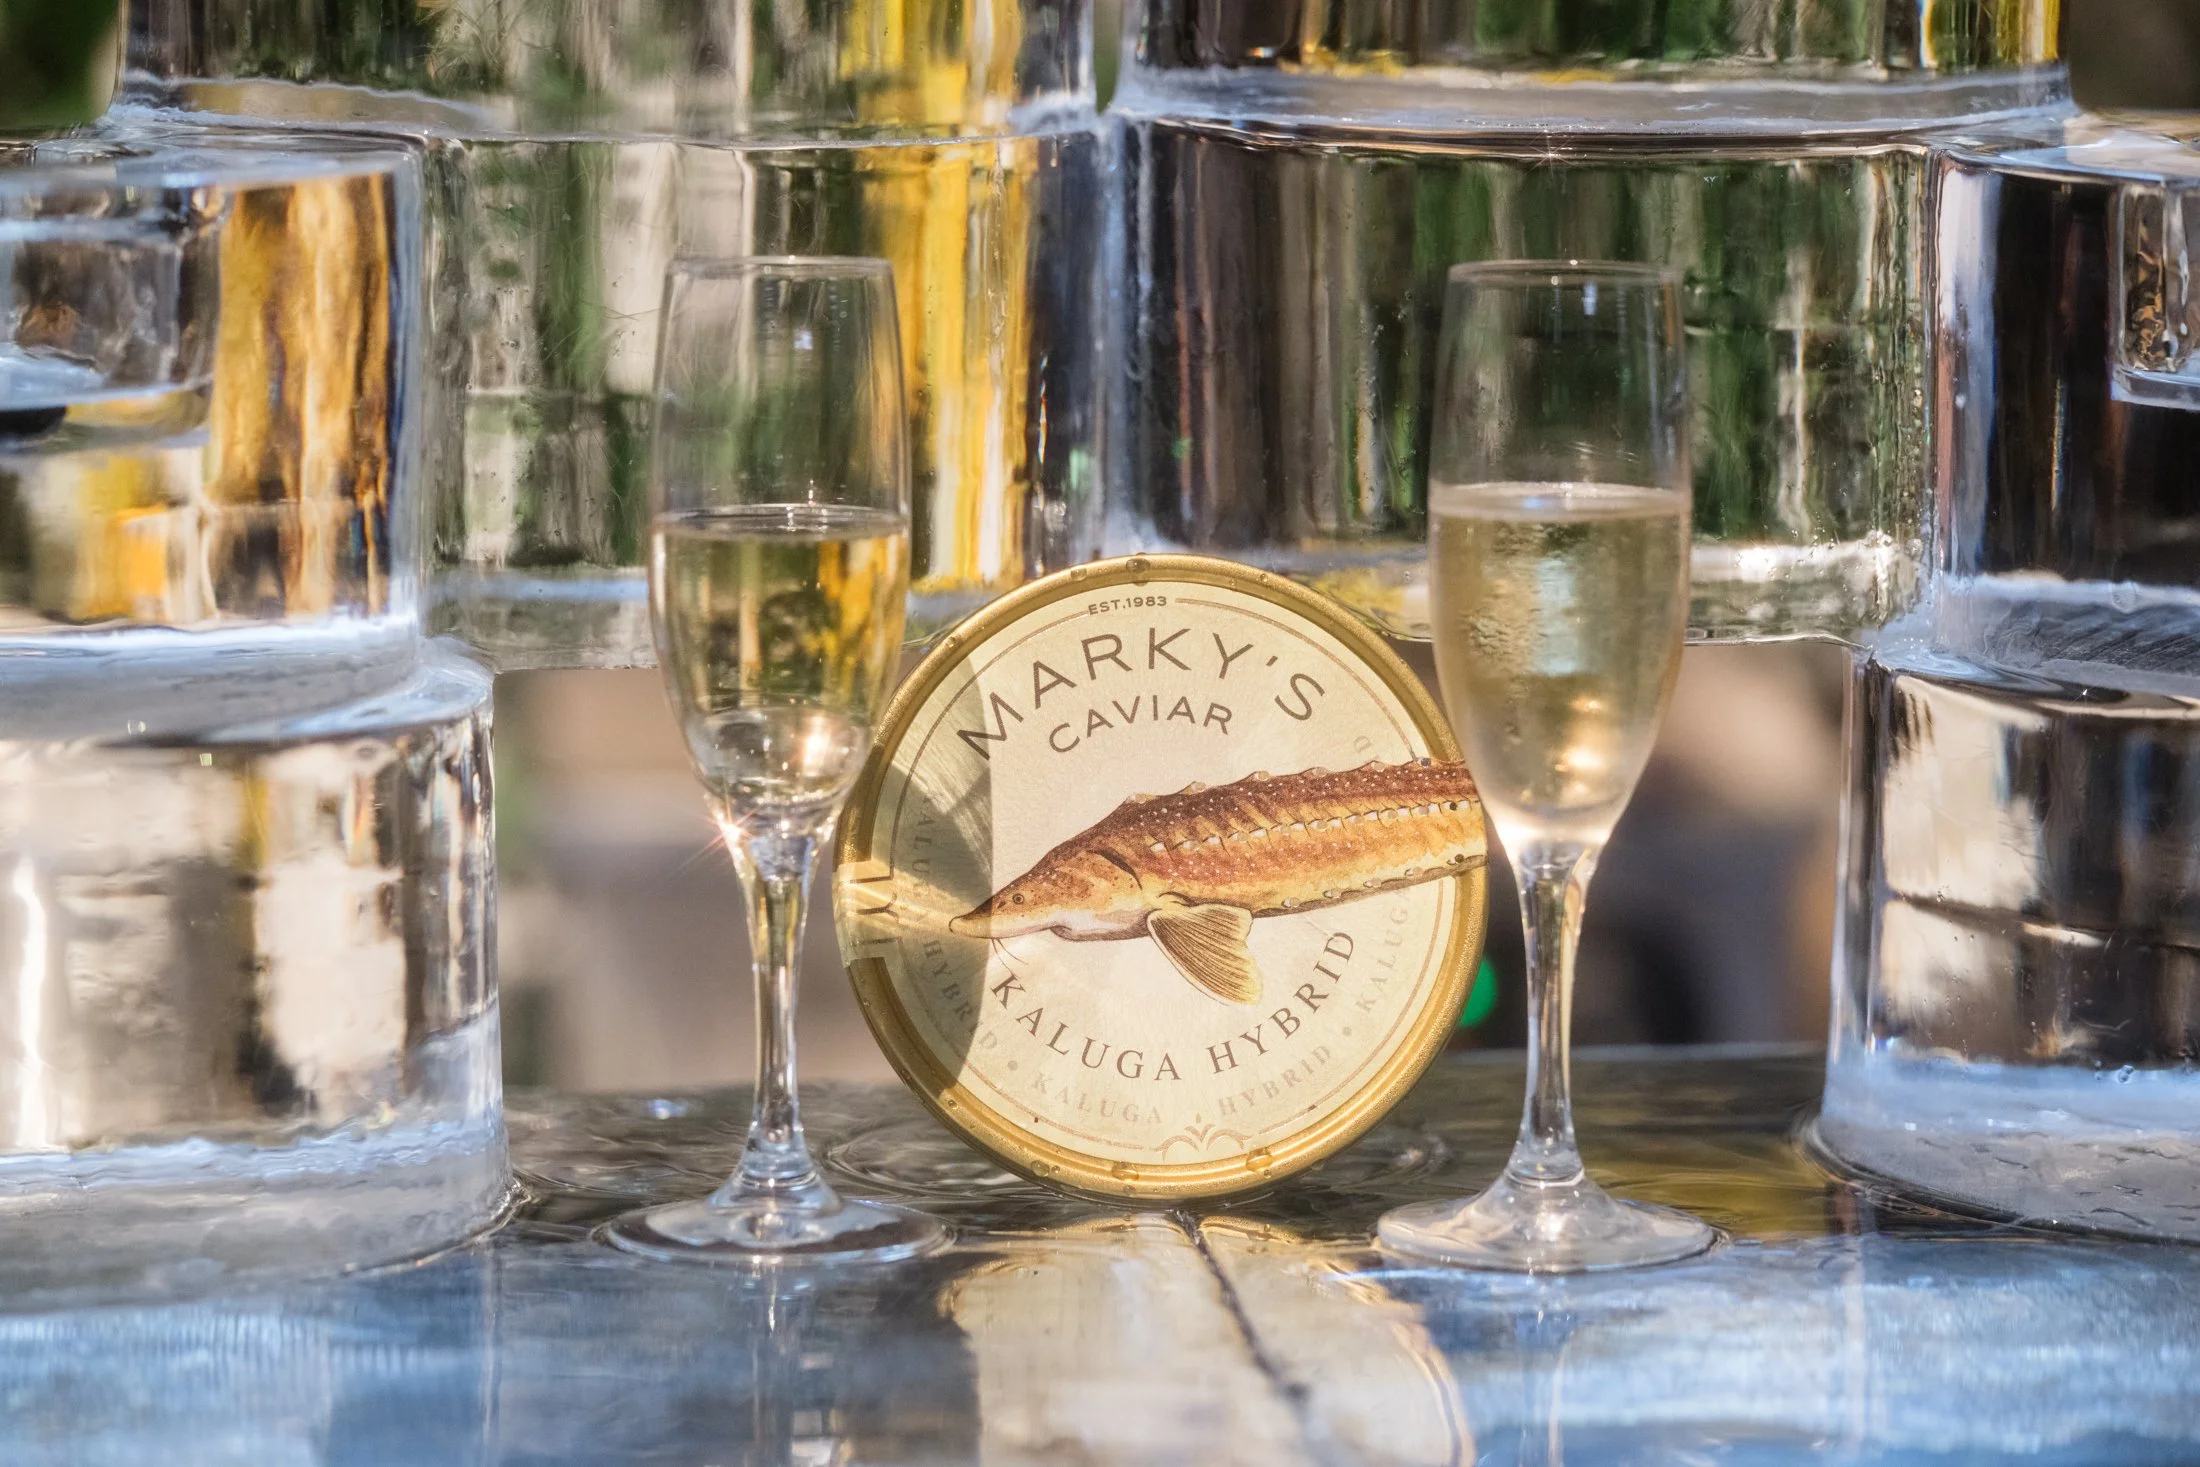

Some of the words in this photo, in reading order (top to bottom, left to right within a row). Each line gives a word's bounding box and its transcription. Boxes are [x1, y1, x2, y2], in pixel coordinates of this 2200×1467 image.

[1088, 596, 1168, 616] EST.1983
[956, 627, 1326, 762] MARKY'S
[1048, 694, 1234, 754] CAVIAR
[990, 973, 1183, 1082] KALUGA
[1205, 931, 1355, 1075] HYBRID
[1030, 1071, 1163, 1125] KALUGA
[1217, 1044, 1333, 1117] HYBRID
